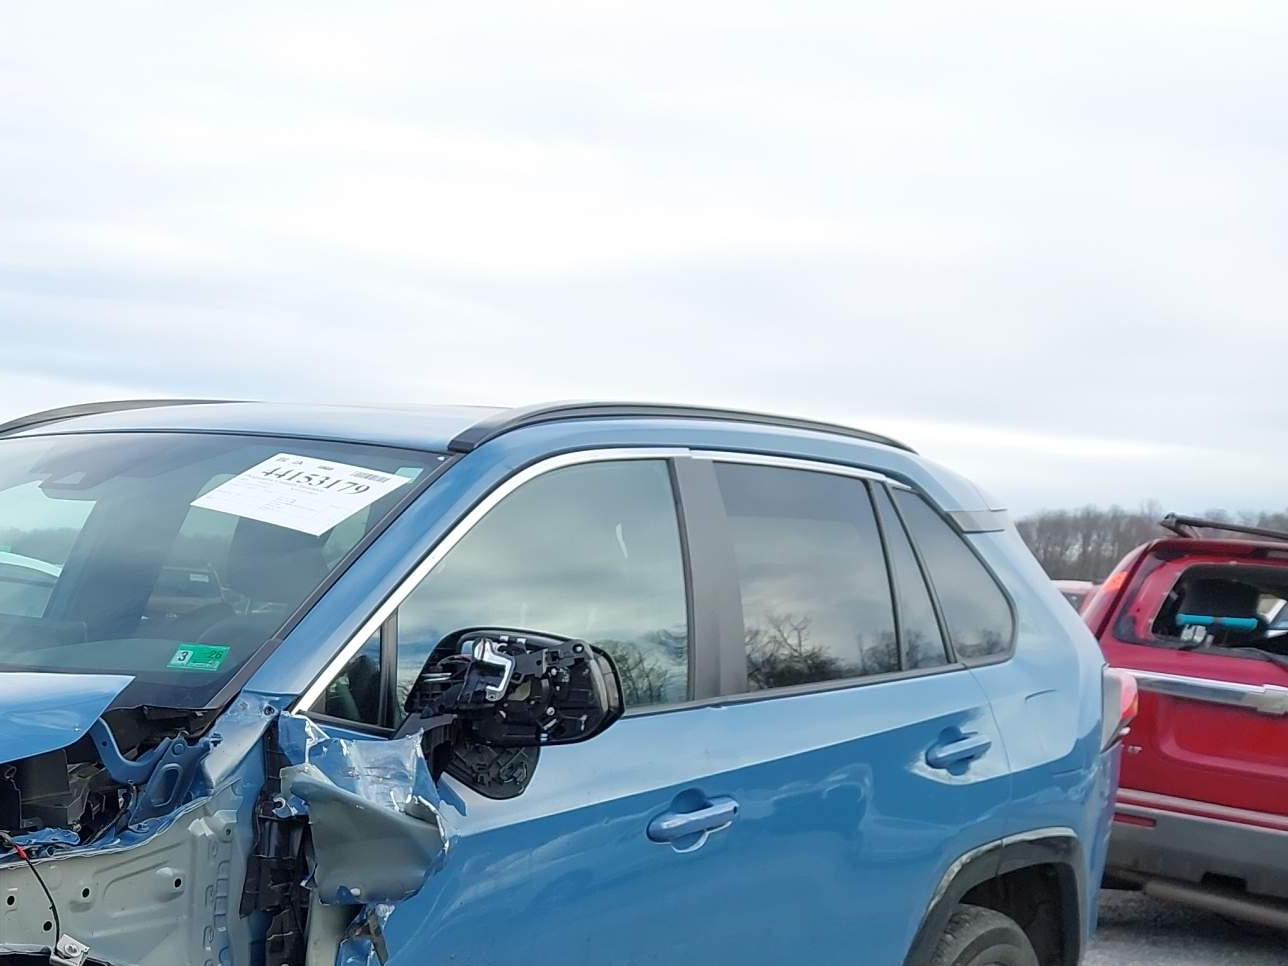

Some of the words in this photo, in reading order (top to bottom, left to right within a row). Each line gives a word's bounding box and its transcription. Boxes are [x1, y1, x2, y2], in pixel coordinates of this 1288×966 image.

[261, 467, 371, 495] 44153179
[177, 650, 189, 662] 3
[209, 649, 224, 660] 26
